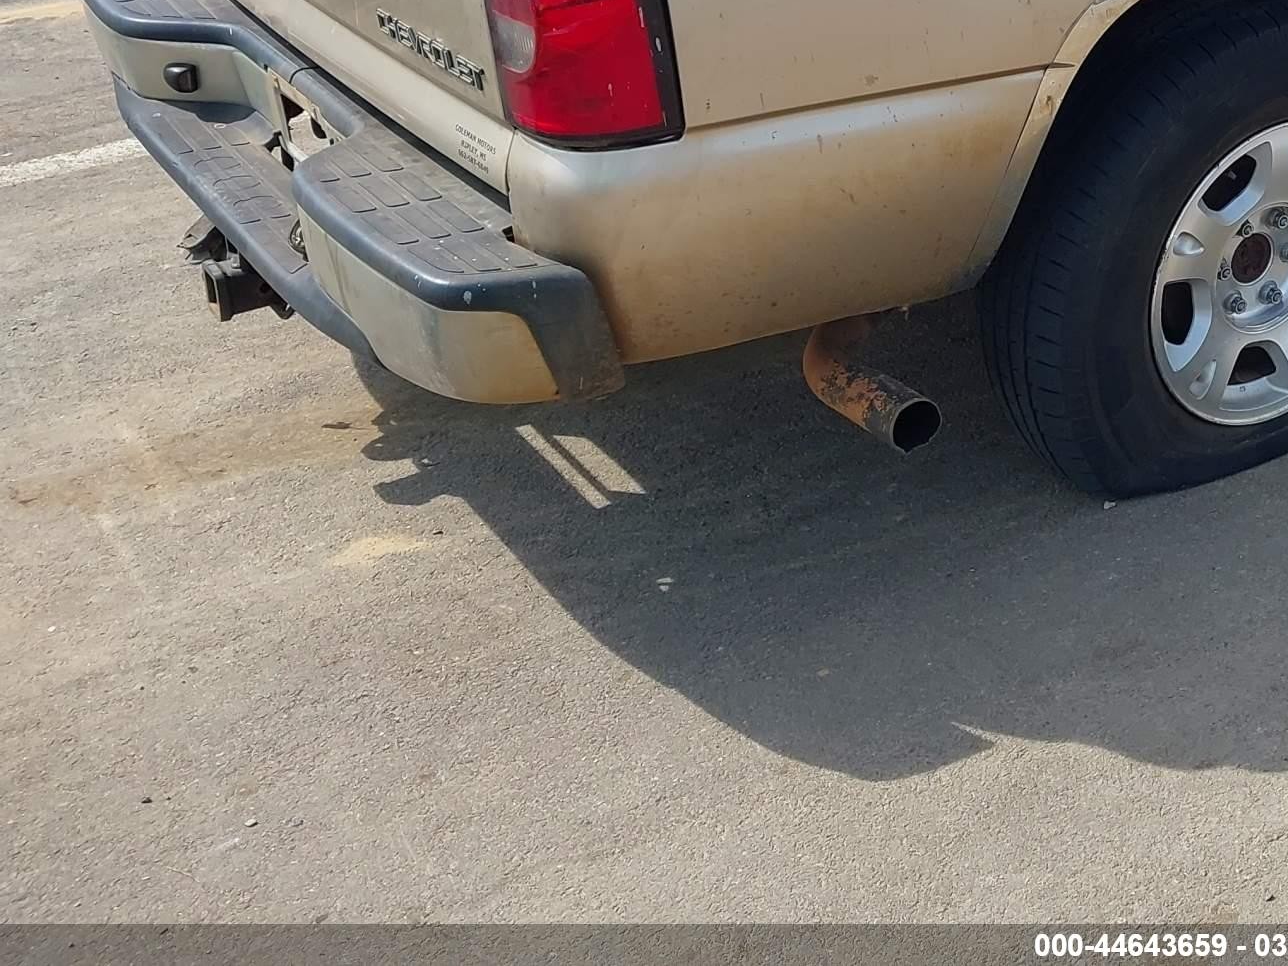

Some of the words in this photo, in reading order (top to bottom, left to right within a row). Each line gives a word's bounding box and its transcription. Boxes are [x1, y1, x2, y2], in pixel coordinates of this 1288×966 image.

[376, 7, 485, 92] CHEVROLET
[455, 123, 477, 143] COLEMAN
[477, 137, 496, 155] MOTORS
